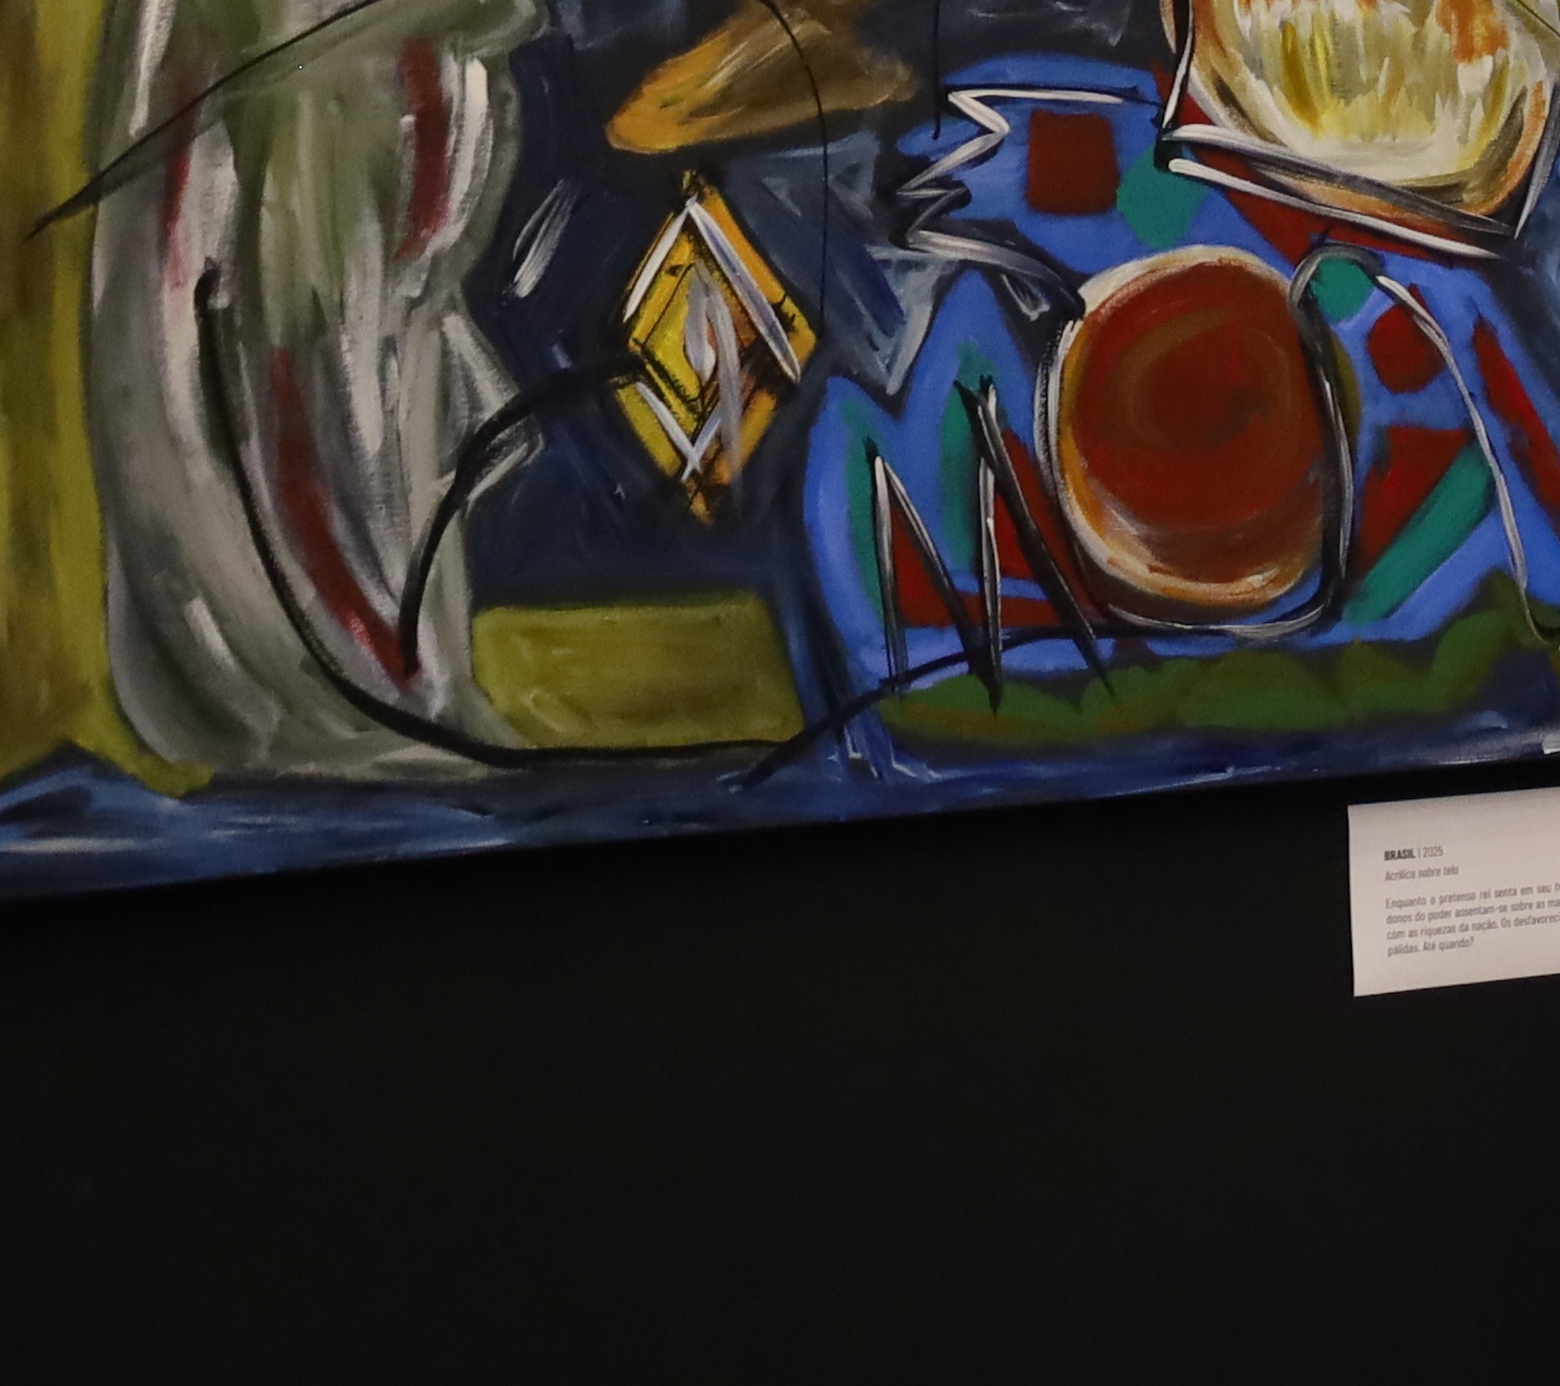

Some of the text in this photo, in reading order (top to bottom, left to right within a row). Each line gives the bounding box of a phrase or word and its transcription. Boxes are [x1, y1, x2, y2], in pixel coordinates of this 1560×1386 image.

[1383, 848, 1416, 861] BRASIL
[1423, 845, 1443, 857] 2025
[1417, 867, 1441, 878] sobre
[1443, 864, 1459, 876] tela
[1385, 896, 1427, 909] Enquanto
[1438, 892, 1476, 905] pretenso
[1479, 888, 1491, 900] rei
[1493, 887, 1517, 898] senta
[1519, 886, 1534, 896] em
[1536, 884, 1552, 894] seu
[1385, 914, 1413, 924] donos
[1414, 911, 1426, 922] do
[1427, 909, 1452, 922] poder
[1510, 901, 1534, 912] sobre
[1386, 930, 1405, 940] com
[1420, 925, 1456, 937] riquezas
[1458, 922, 1470, 933] da
[1500, 917, 1512, 928] Os
[1438, 936, 1475, 951] quando?
